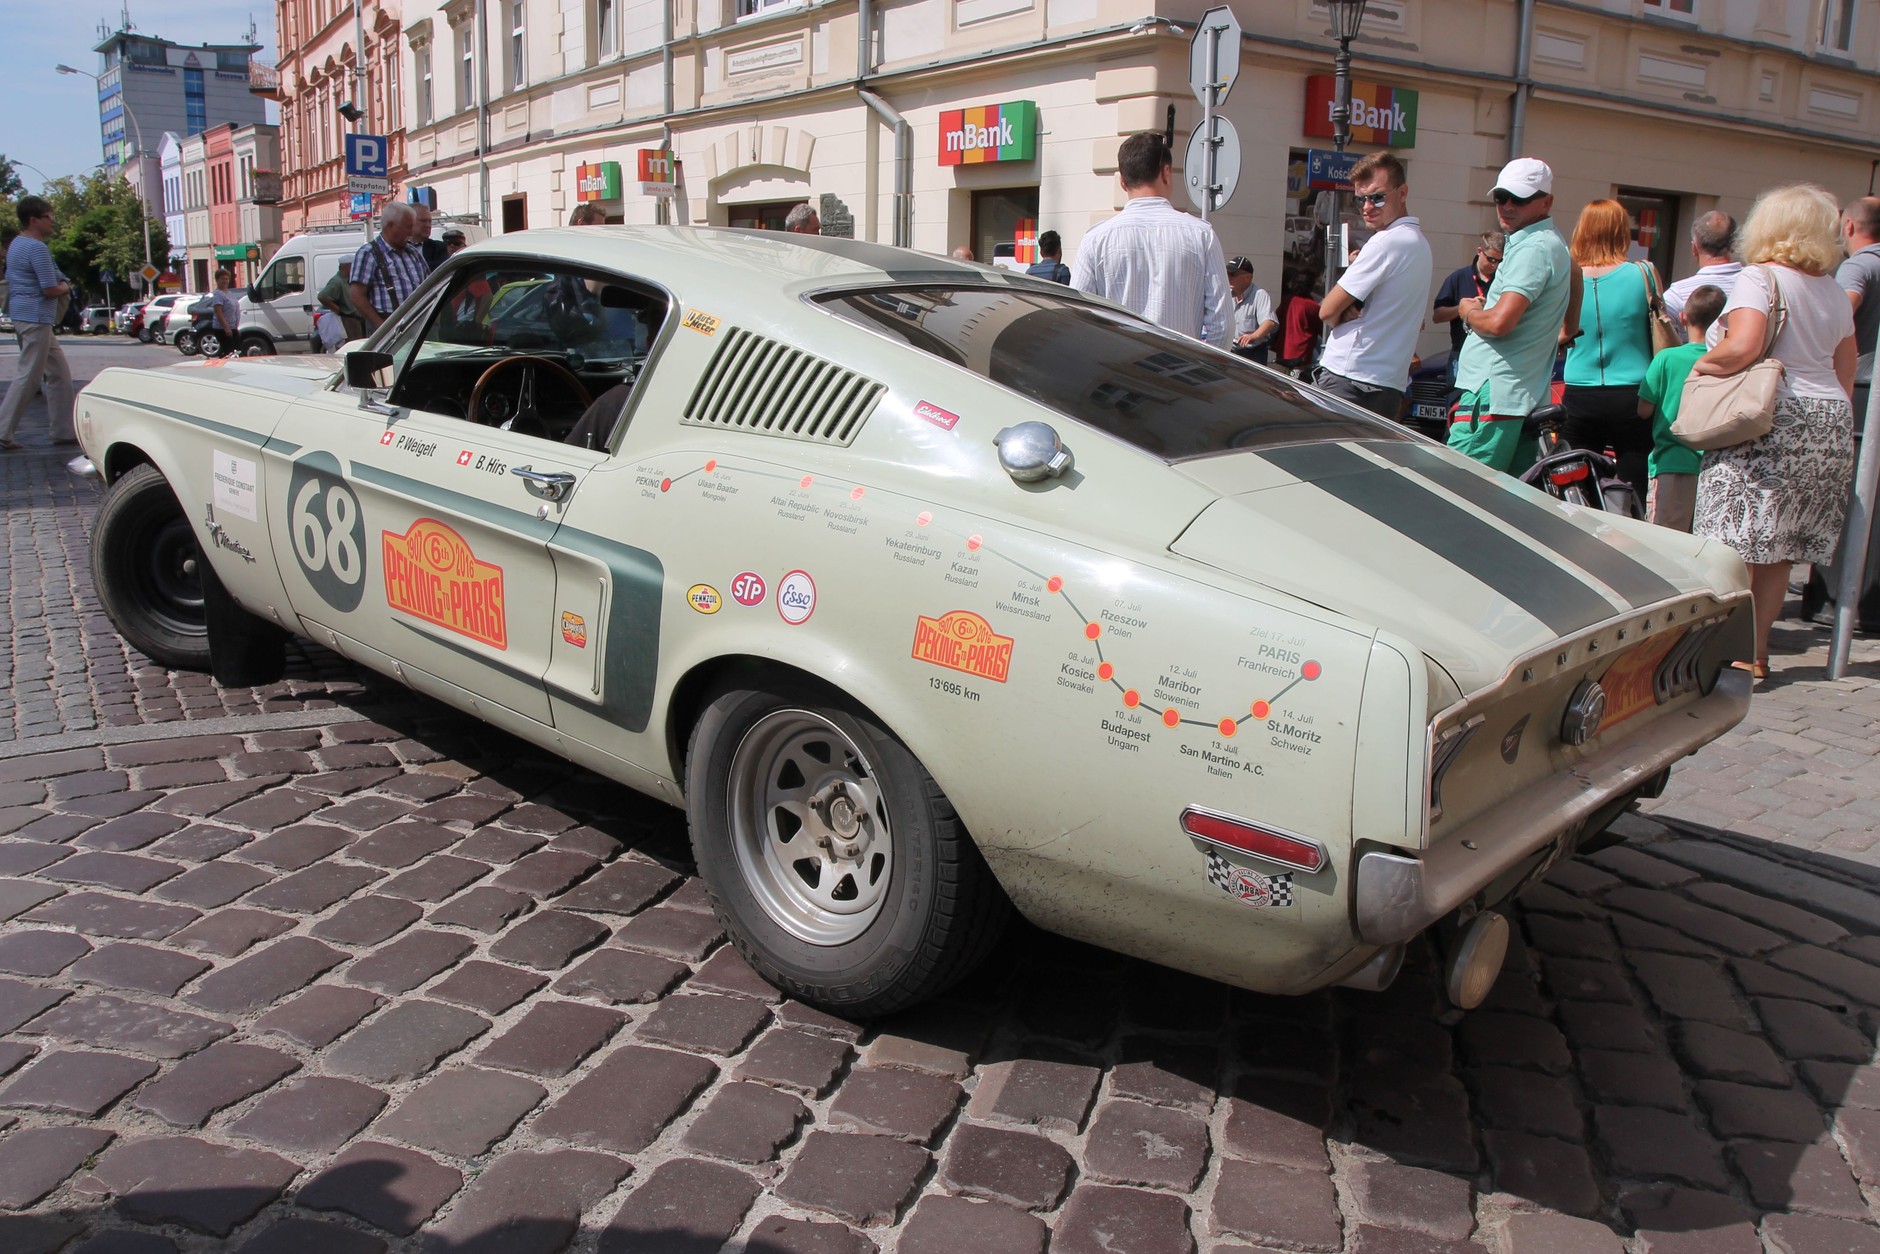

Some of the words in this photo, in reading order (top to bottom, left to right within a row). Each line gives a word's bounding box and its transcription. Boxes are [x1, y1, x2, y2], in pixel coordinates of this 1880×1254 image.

[946, 118, 1013, 151] mBank
[356, 139, 378, 170] P
[648, 158, 670, 174] m
[1328, 165, 1351, 180] Kości
[351, 182, 386, 191] Bezpłatny
[580, 171, 607, 192] mBank
[691, 320, 715, 333] Meter
[696, 314, 716, 326] Auto
[917, 405, 953, 426] Edelbrock
[475, 455, 486, 471] B.
[485, 457, 507, 476] Hirs
[236, 479, 255, 493] CONSTANT
[635, 476, 660, 488] PEKING
[698, 479, 716, 490] Ulaan
[716, 482, 739, 495] Baatar
[641, 489, 656, 499] China
[702, 491, 727, 503] Mongolei
[770, 496, 788, 507] Altai
[787, 499, 820, 514] Republic
[777, 509, 806, 521] Russland
[823, 508, 869, 526] Novosibirsk
[293, 478, 361, 585] 68
[827, 521, 857, 535] Russland
[905, 530, 914, 538] 29.
[915, 532, 929, 541] Juni
[407, 530, 422, 563] 1907
[431, 537, 449, 564] 6th
[456, 543, 475, 578] 2016
[885, 537, 942, 559] Yekaterinburg
[893, 552, 925, 566] Russland
[957, 551, 966, 560] 01.
[968, 553, 981, 562] Juli
[950, 561, 979, 577] Kazan
[734, 575, 762, 600] STP
[944, 573, 979, 589] Russland
[1017, 580, 1028, 589] 05.
[1029, 583, 1043, 593] Juli
[385, 540, 445, 620] PEKING
[442, 592, 450, 611] TO
[450, 577, 503, 643] PARIS
[692, 593, 718, 604] PENNZOIL
[782, 583, 811, 607] Esso
[1011, 591, 1040, 607] Minsk
[995, 601, 1051, 622] Weissrussland
[1114, 599, 1125, 608] 07.
[1127, 602, 1143, 612] Juli
[1100, 609, 1148, 629] Rzeszow
[958, 620, 974, 635] 6th
[976, 624, 993, 645] 2016
[1107, 625, 1132, 639] Polen
[1249, 626, 1268, 639] Ziel
[1271, 631, 1284, 643] 17.
[1287, 636, 1306, 647] Juli
[915, 620, 962, 666] PEKING
[965, 643, 1011, 679] PARIS
[1257, 644, 1301, 664] PARIS
[1068, 652, 1079, 661] 08.
[1080, 655, 1095, 665] Juli
[1061, 663, 1095, 681] Kosice
[1169, 665, 1181, 675] 12.
[1182, 668, 1198, 679] Juli
[1237, 656, 1296, 680] Frankreich
[1057, 676, 1094, 694] Slowakei
[1158, 675, 1202, 695] Maribor
[964, 687, 981, 702] km
[1153, 688, 1200, 709] Slowenien
[1115, 710, 1126, 720] 10.
[1127, 714, 1142, 725] Juli
[1282, 709, 1295, 720] 14.
[1297, 713, 1314, 725] Juli
[1101, 719, 1151, 743] Budapest
[1267, 719, 1322, 743] St.Moritz
[1107, 736, 1139, 752] Ungarn
[1211, 741, 1222, 751] 13.
[1223, 743, 1238, 755] Juli
[1270, 736, 1312, 755] Schweiz
[1180, 744, 1199, 757] San
[1201, 750, 1241, 769] Martino
[1243, 762, 1264, 776] A.C.
[1207, 765, 1233, 779] Italien
